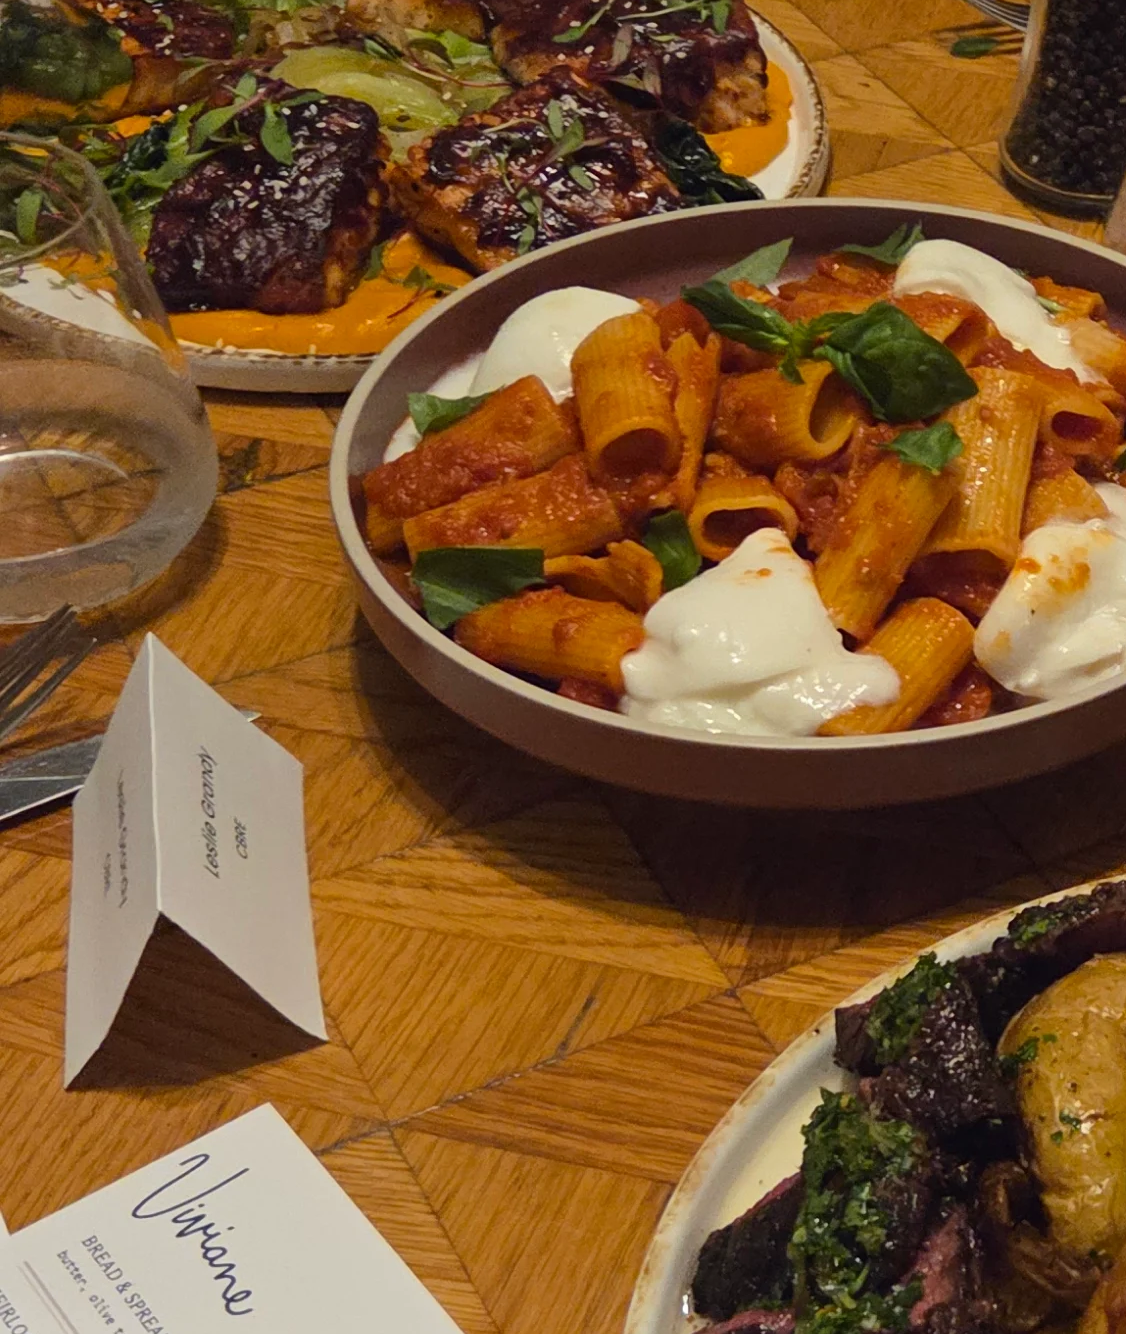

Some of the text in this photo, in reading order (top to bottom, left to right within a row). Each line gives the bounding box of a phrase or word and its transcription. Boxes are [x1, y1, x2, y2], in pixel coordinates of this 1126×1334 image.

[81, 1234, 123, 1281] BREAD
[115, 1281, 132, 1295] &
[131, 1152, 254, 1317] Viviane
[56, 1249, 87, 1293] butter,
[89, 1294, 115, 1325] olive
